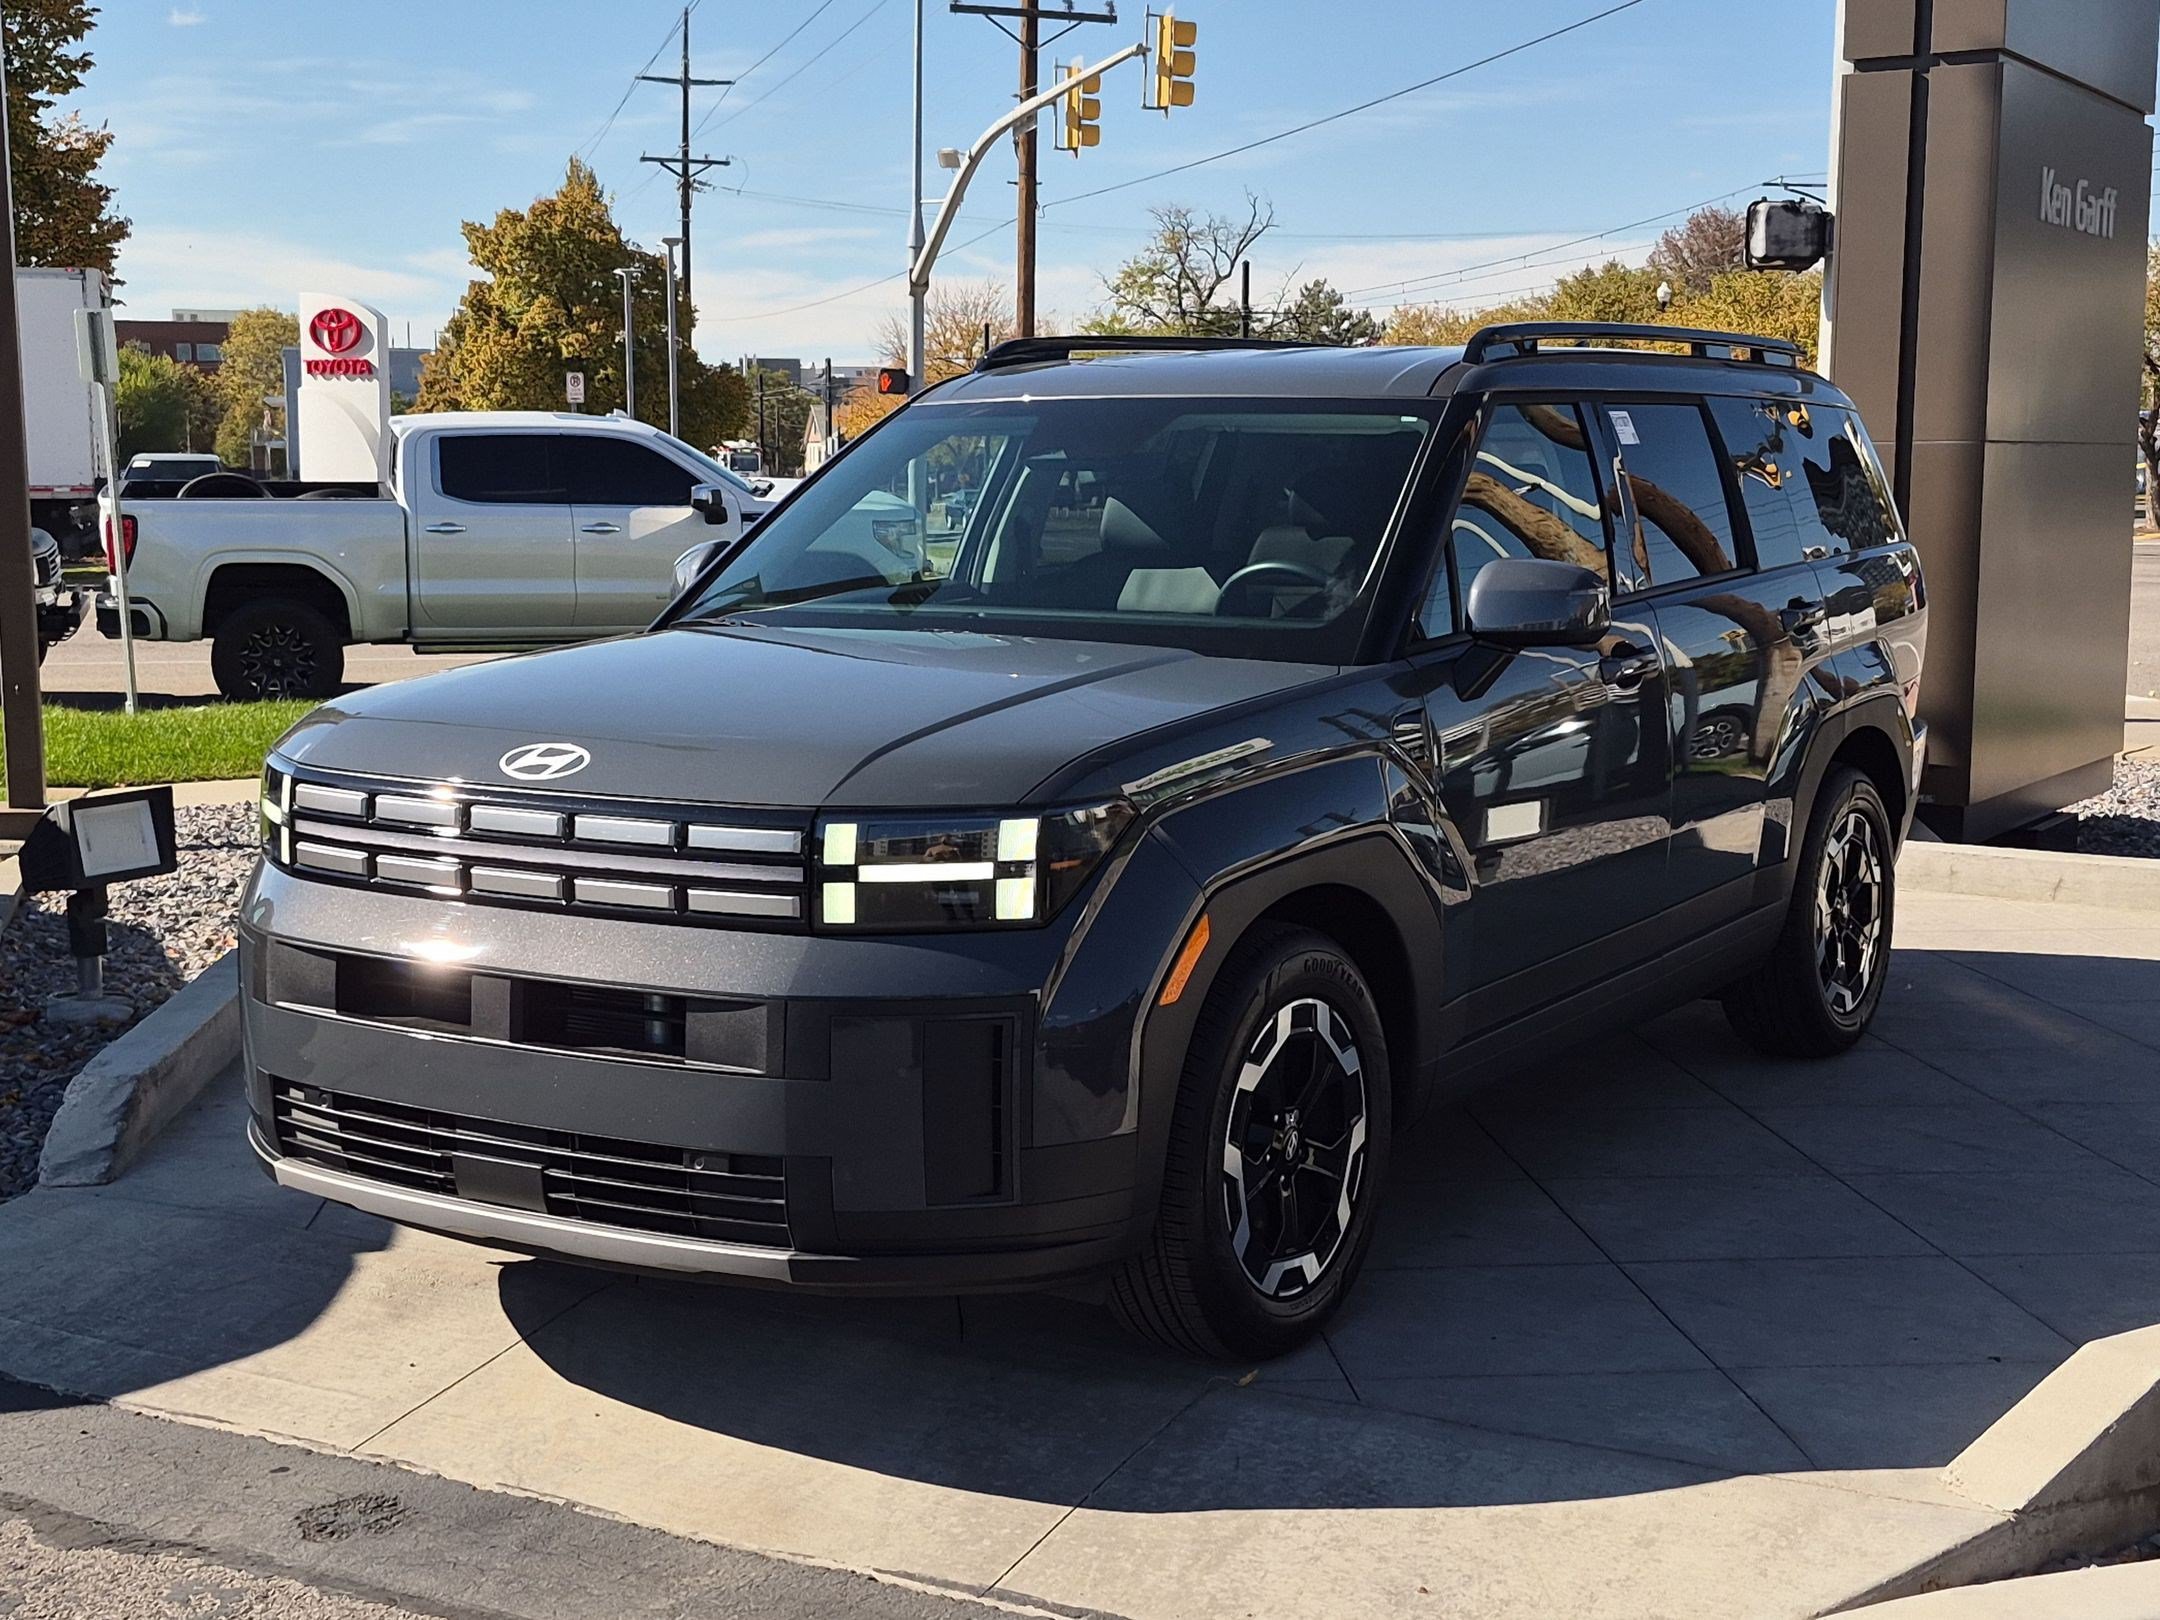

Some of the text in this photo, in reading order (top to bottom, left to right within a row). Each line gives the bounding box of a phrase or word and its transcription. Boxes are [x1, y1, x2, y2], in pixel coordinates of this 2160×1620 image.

[2041, 166, 2117, 239] Ken Garff
[304, 359, 373, 375] TOYOTA
[1304, 958, 1364, 999] GOODYEAR
